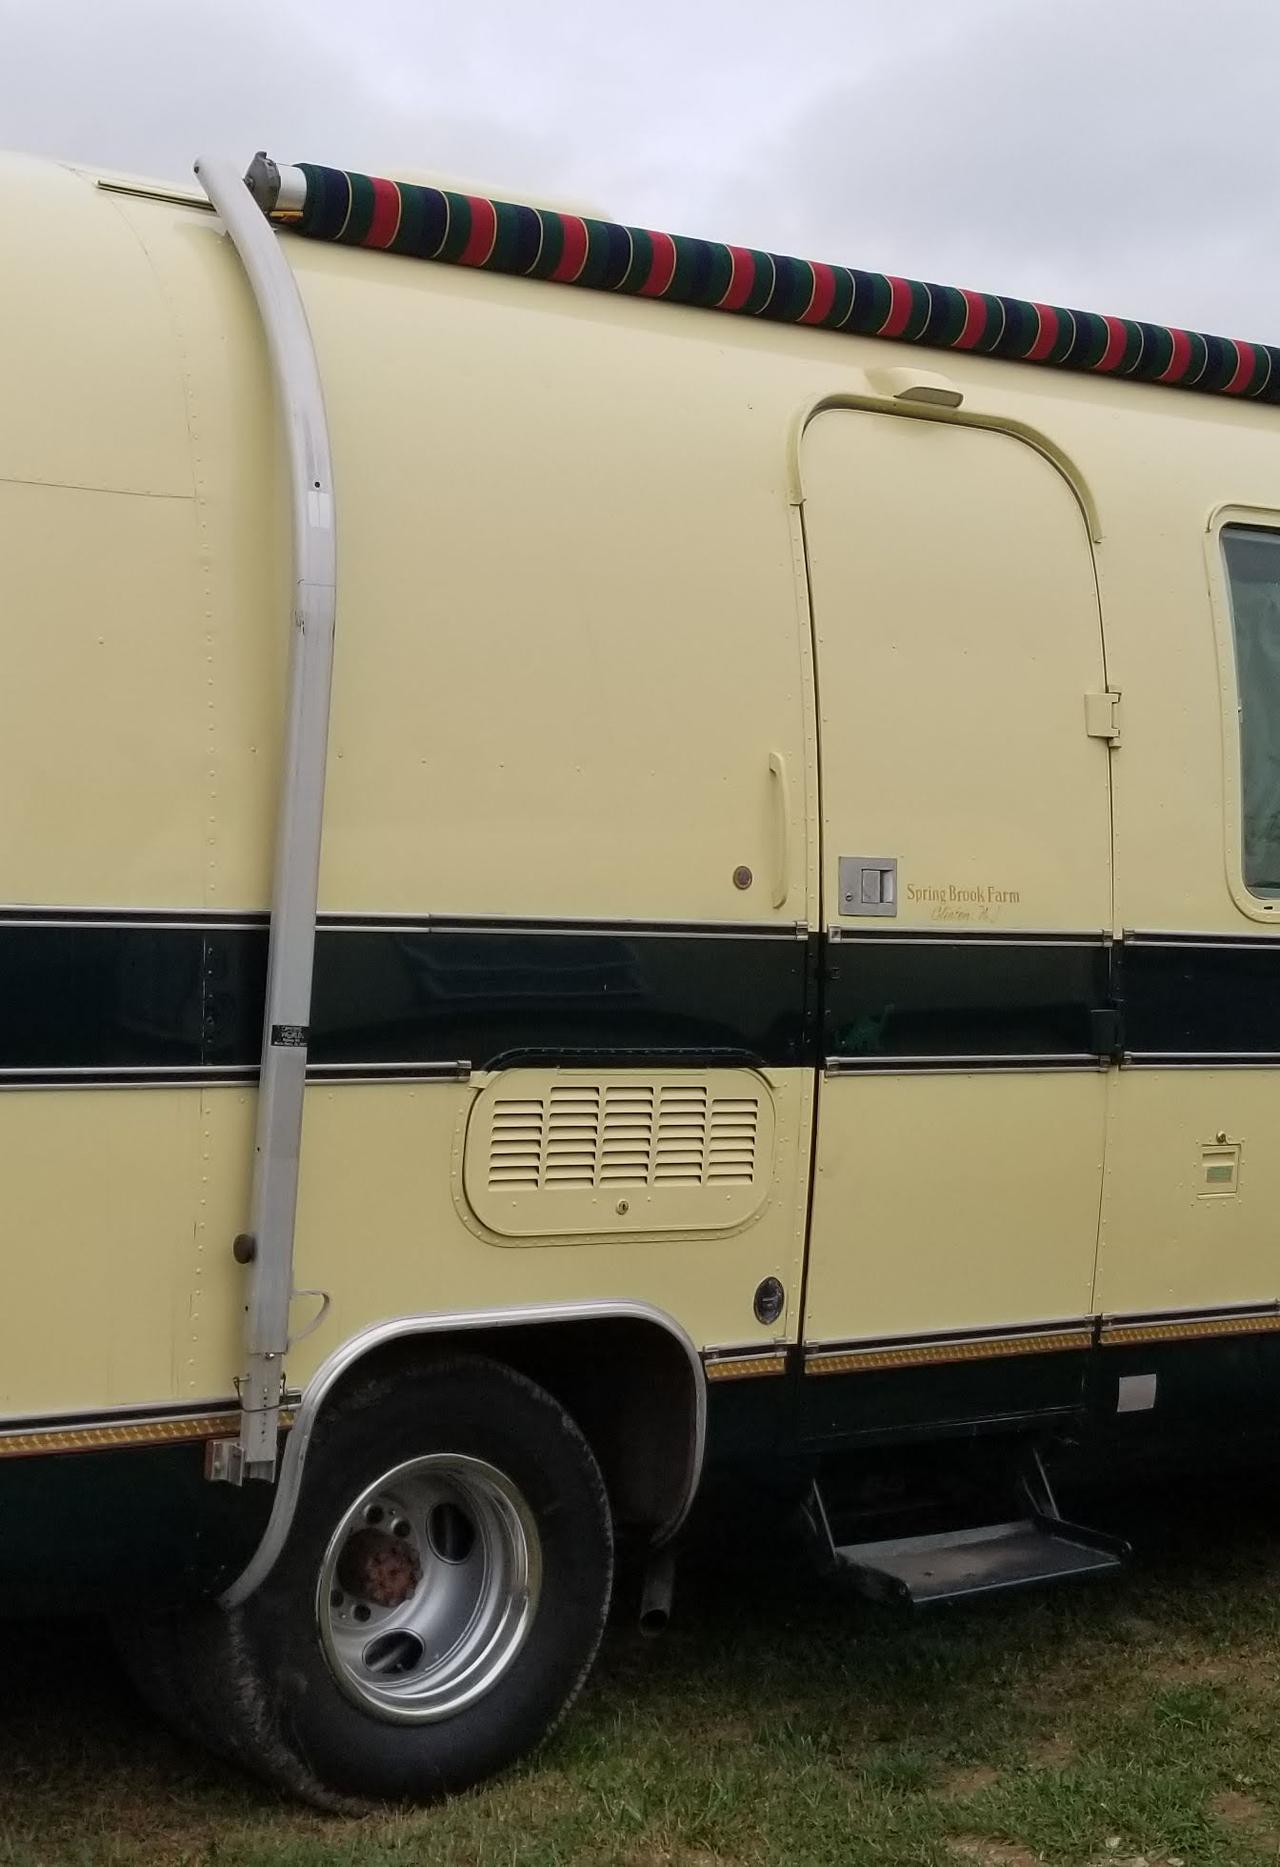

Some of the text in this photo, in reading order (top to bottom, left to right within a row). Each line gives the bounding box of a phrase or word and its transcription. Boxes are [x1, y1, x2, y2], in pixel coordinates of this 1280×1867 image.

[906, 883, 1020, 904] Spring Brook Farm
